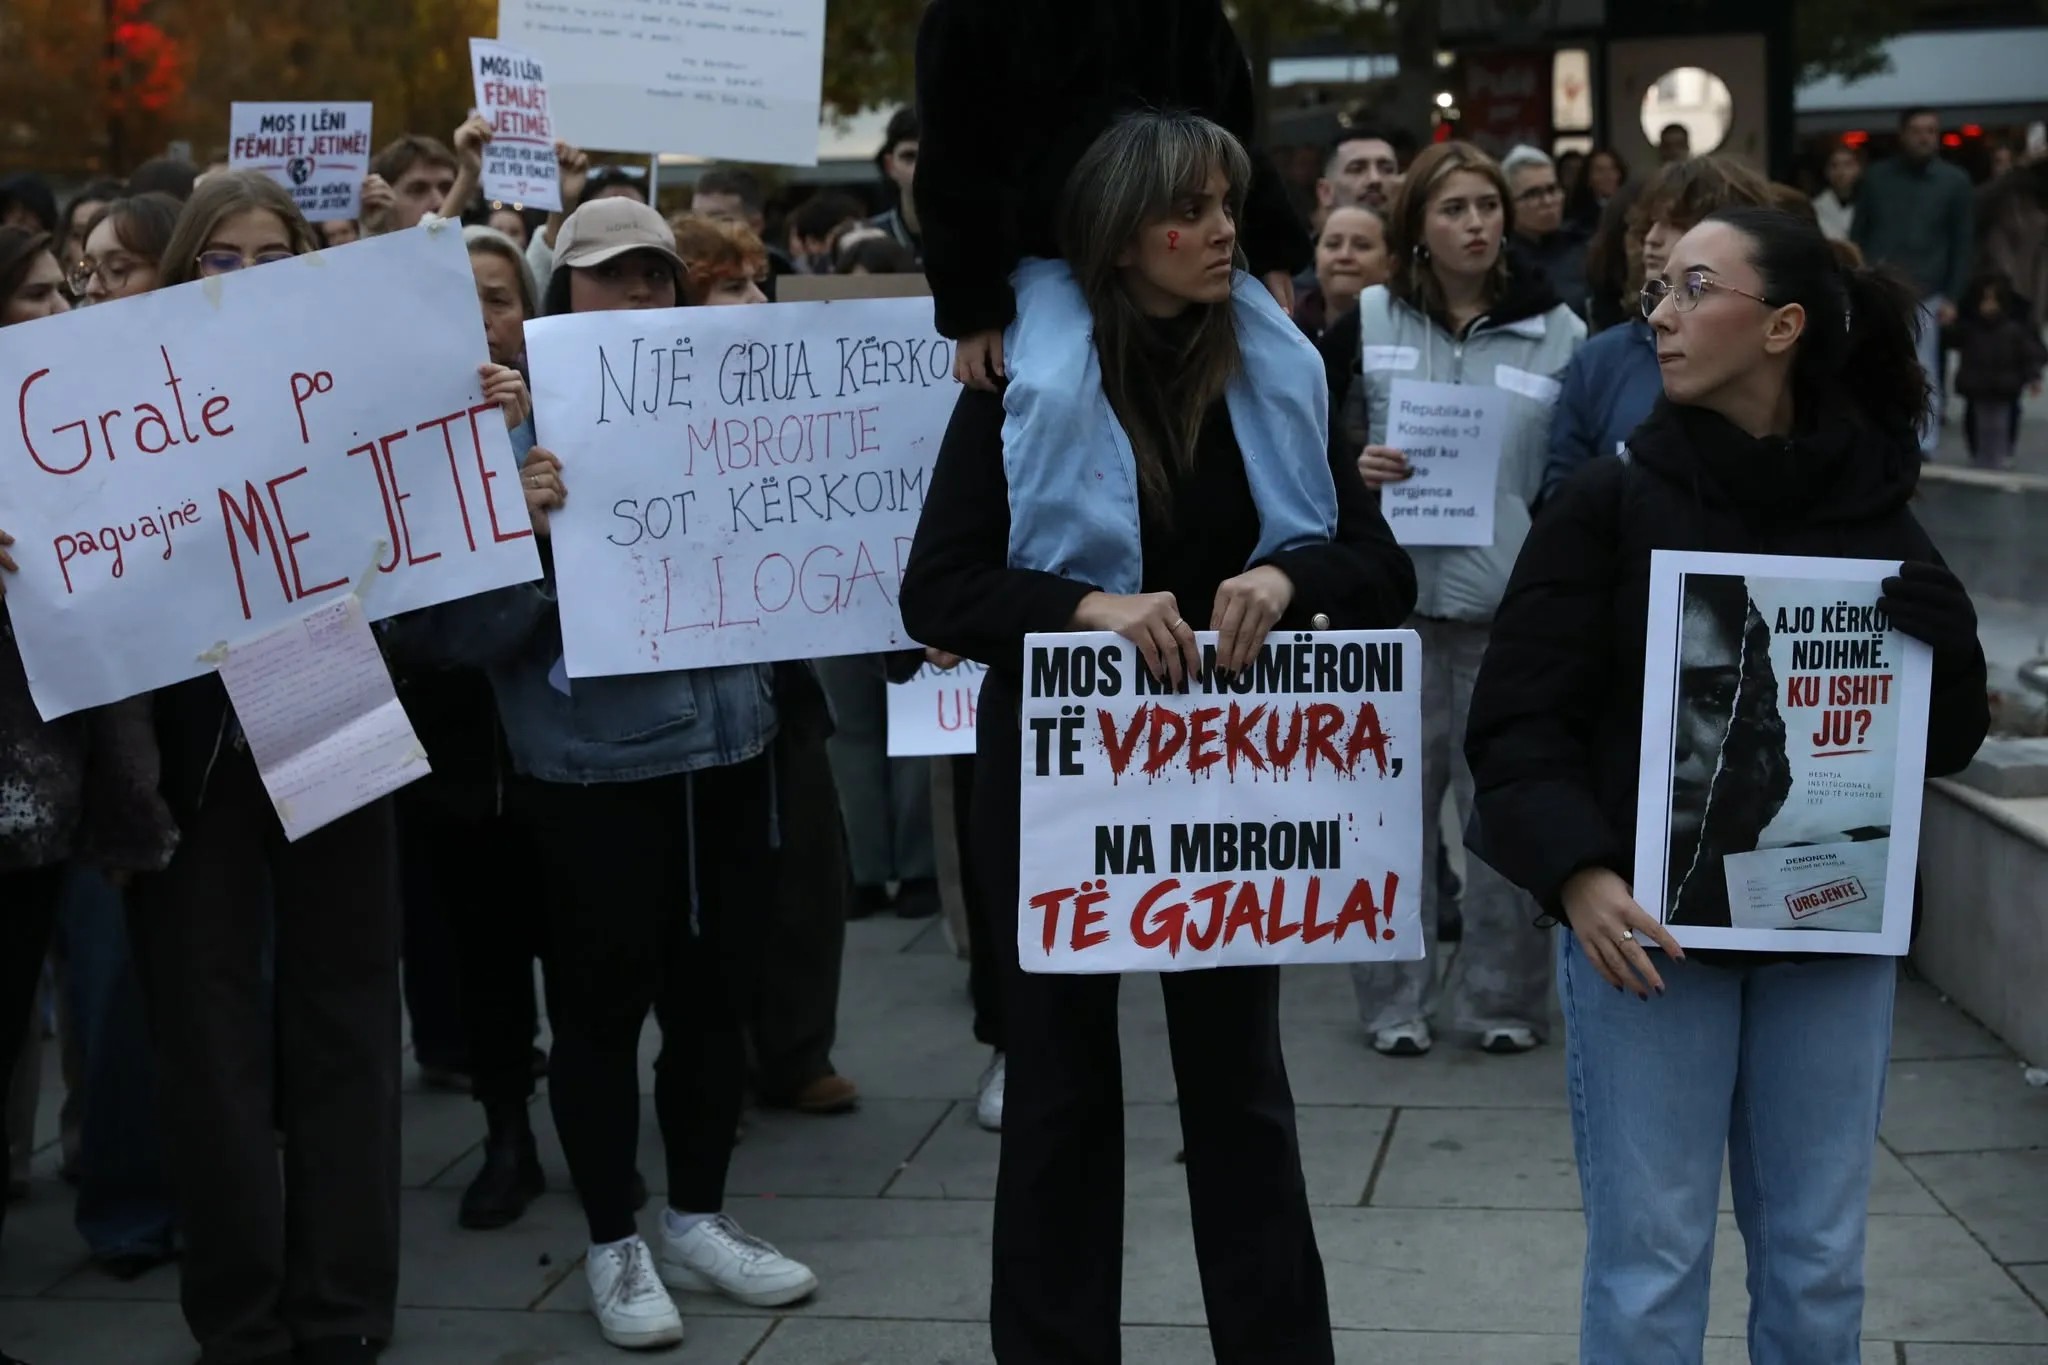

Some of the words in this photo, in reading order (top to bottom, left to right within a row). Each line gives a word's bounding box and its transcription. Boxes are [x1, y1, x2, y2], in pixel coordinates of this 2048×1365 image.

[480, 56, 510, 77] MOS
[514, 62, 518, 77] I
[261, 113, 296, 133] MOS
[301, 114, 306, 131] I
[312, 108, 346, 131] LËNI
[234, 132, 305, 159] FËMIJËT
[308, 130, 367, 155] JETIMË!
[597, 336, 694, 425] NJË
[718, 340, 821, 407] GRUA
[836, 336, 956, 397] KËRKO
[19, 345, 234, 475] Gratë
[290, 370, 334, 444] po
[1441, 445, 1459, 458] ku
[607, 490, 696, 546] SOT
[728, 466, 934, 533] KËRKOJM
[1391, 485, 1453, 499] urgjenca
[1391, 505, 1419, 518] pret
[53, 498, 201, 594] paguajnë
[218, 467, 350, 620] ME
[1775, 606, 1815, 634] AJO
[1792, 633, 1889, 670] NDIHMË.
[1030, 645, 1122, 698] MOS
[1787, 676, 1821, 707] KU
[1828, 674, 1893, 706] ISHIT
[1029, 705, 1085, 777] TË
[1095, 700, 1404, 783] VDEKURA,
[1812, 709, 1872, 747] JU?
[1808, 771, 1842, 779] HESHTJA
[1808, 781, 1872, 790] INSTITUCIONALE
[1807, 789, 1830, 797] MUND
[1095, 824, 1156, 875] NA
[1170, 820, 1341, 872] MBRONI
[1785, 853, 1837, 865] DENONCIM
[1792, 882, 1859, 914] URGJENTE
[1029, 878, 1111, 955] TË
[1130, 870, 1400, 959] GJALLA!
